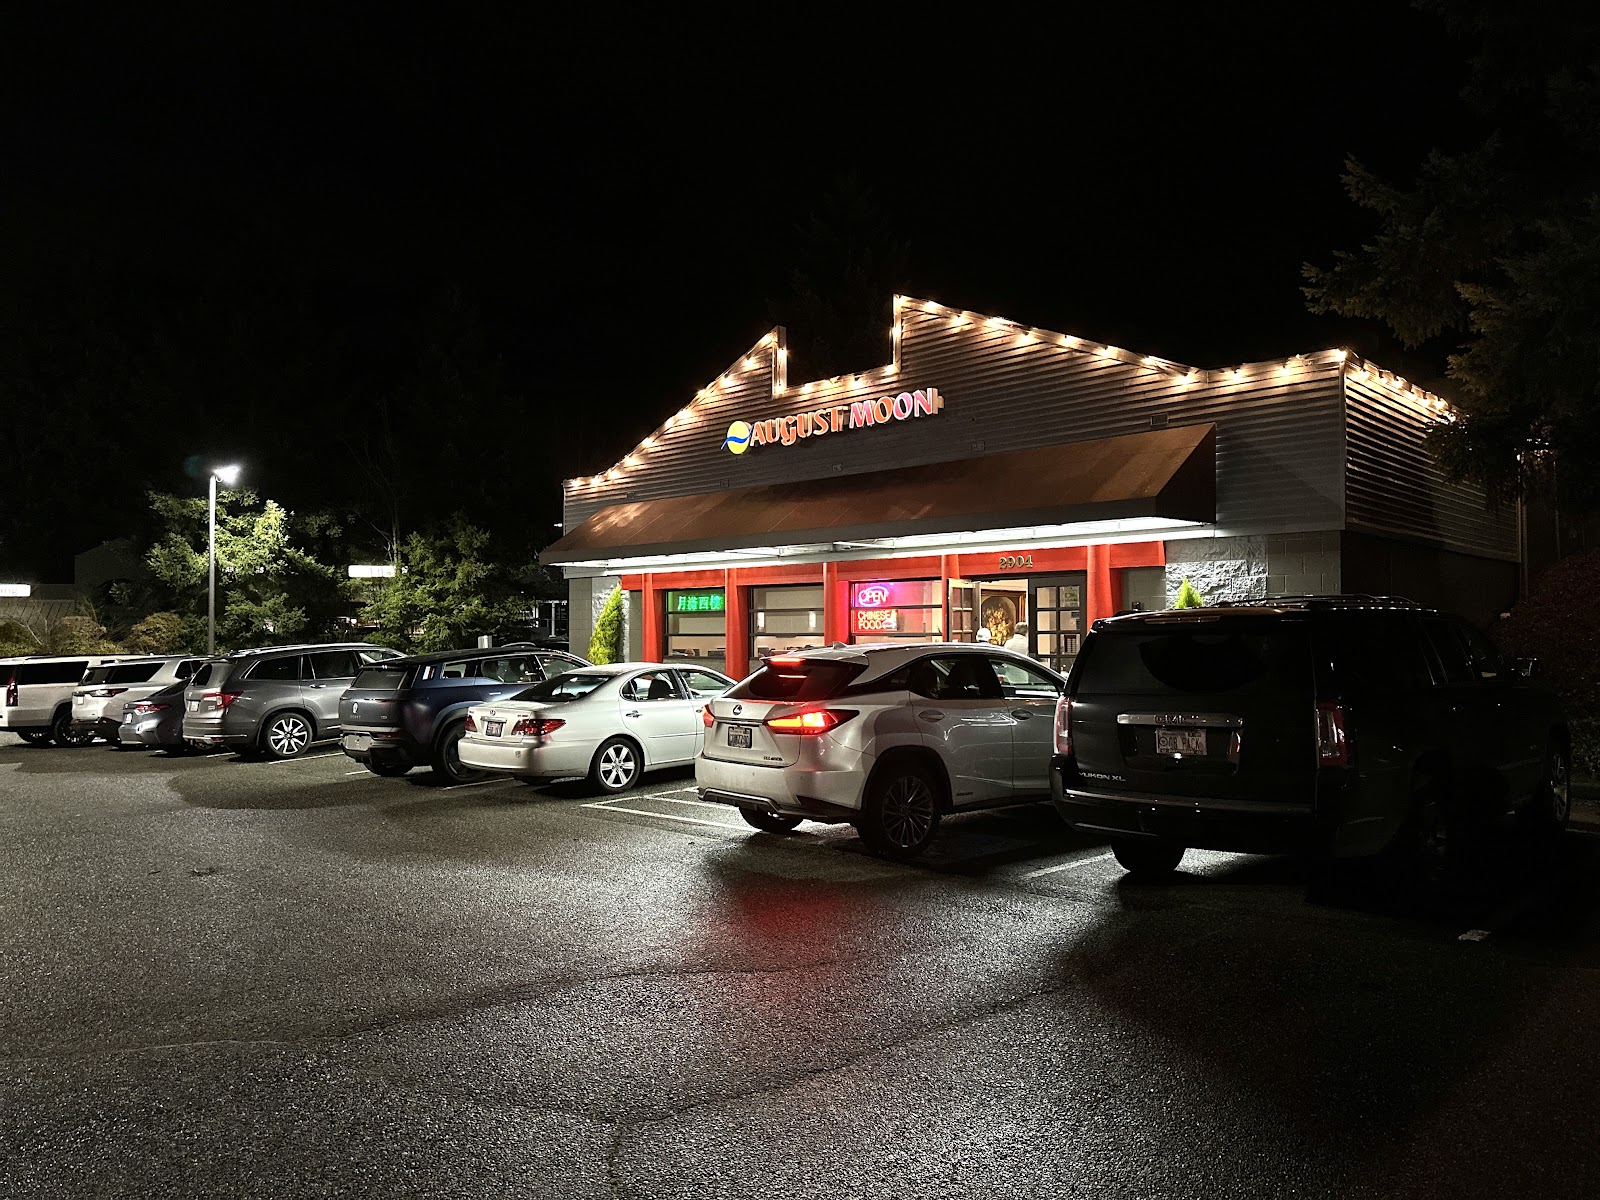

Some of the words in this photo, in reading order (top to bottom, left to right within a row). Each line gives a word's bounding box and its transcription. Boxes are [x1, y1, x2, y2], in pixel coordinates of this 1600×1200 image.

[749, 405, 848, 446] AUGUST
[849, 387, 937, 429] MOON
[999, 554, 1033, 570] 2904
[858, 587, 889, 604] OPEN
[857, 610, 891, 620] CHINESE
[858, 620, 882, 630] FOOD
[1078, 771, 1111, 781] YUKON
[1111, 774, 1127, 782] XL
